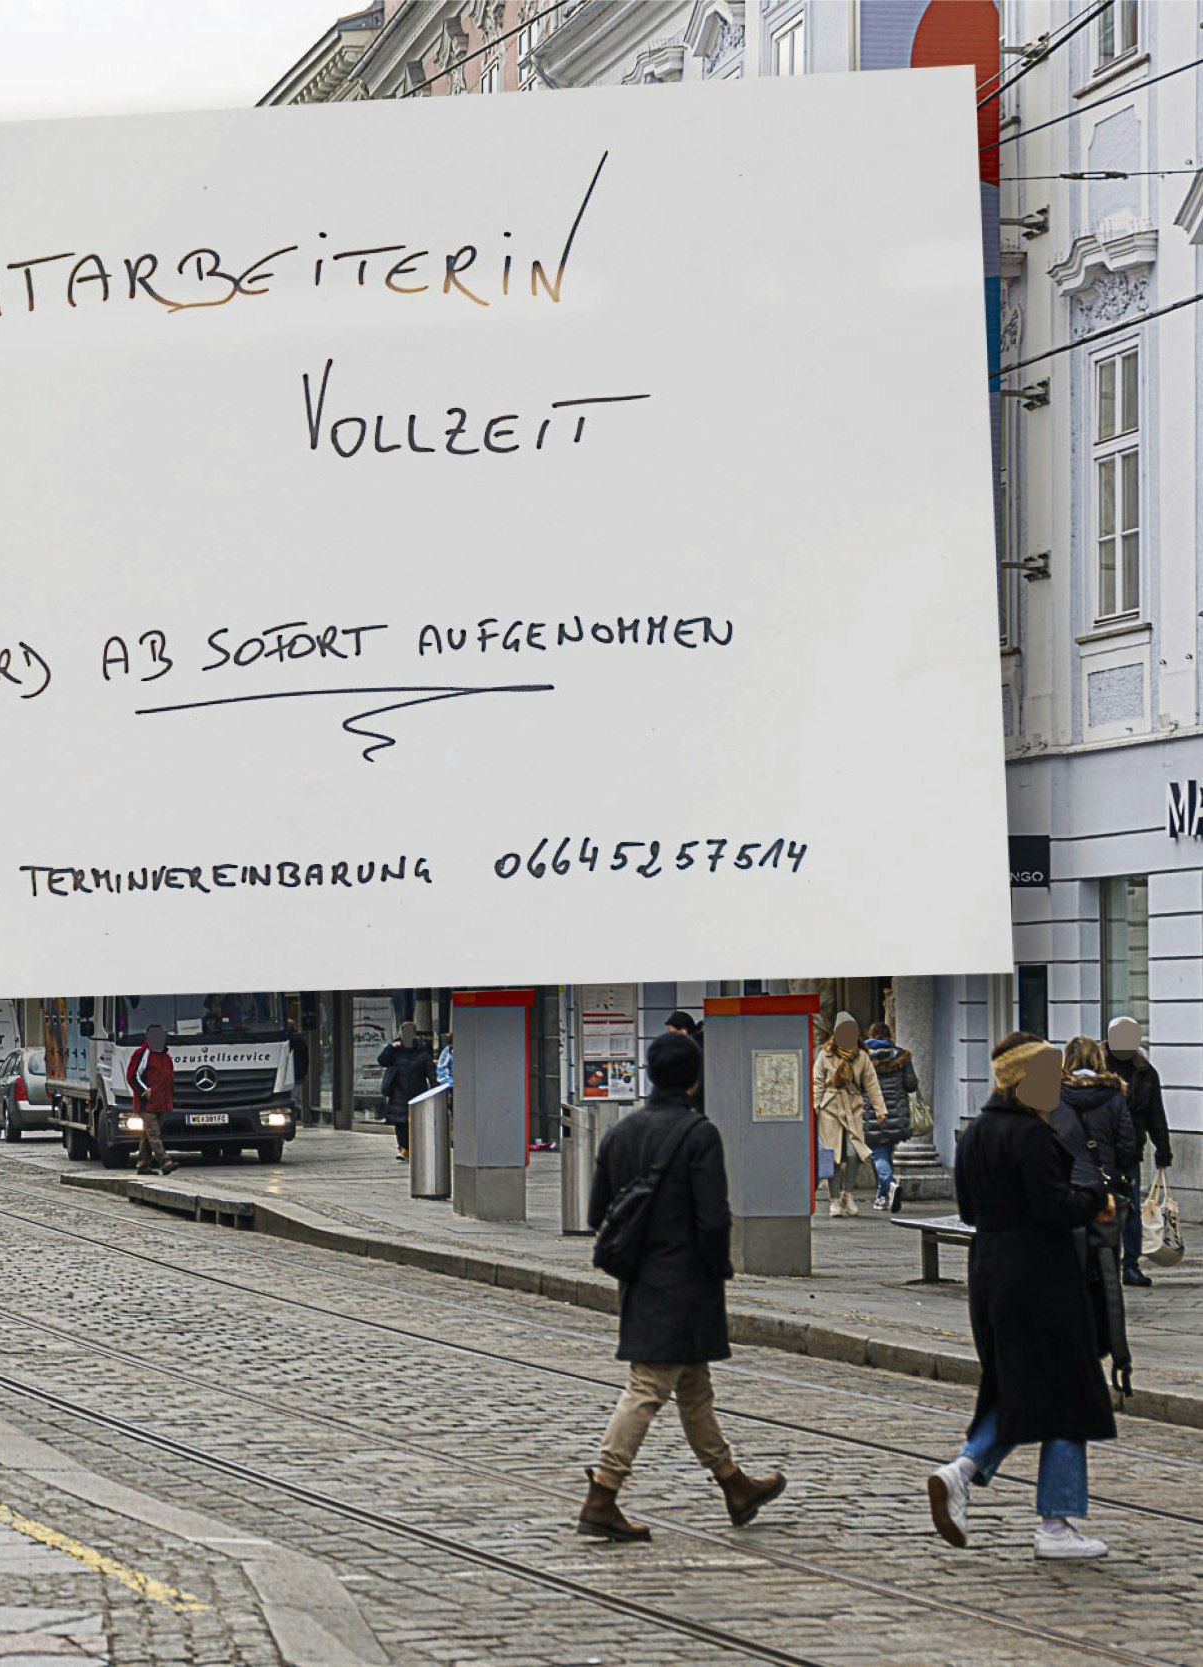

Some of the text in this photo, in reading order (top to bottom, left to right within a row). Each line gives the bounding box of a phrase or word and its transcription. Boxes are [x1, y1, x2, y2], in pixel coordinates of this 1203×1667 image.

[103, 630, 173, 681] AB
[202, 621, 388, 671] SOFORT
[19, 855, 432, 897] TERMINVEREINBARUNG
[171, 1051, 271, 1064] ozustellservice
